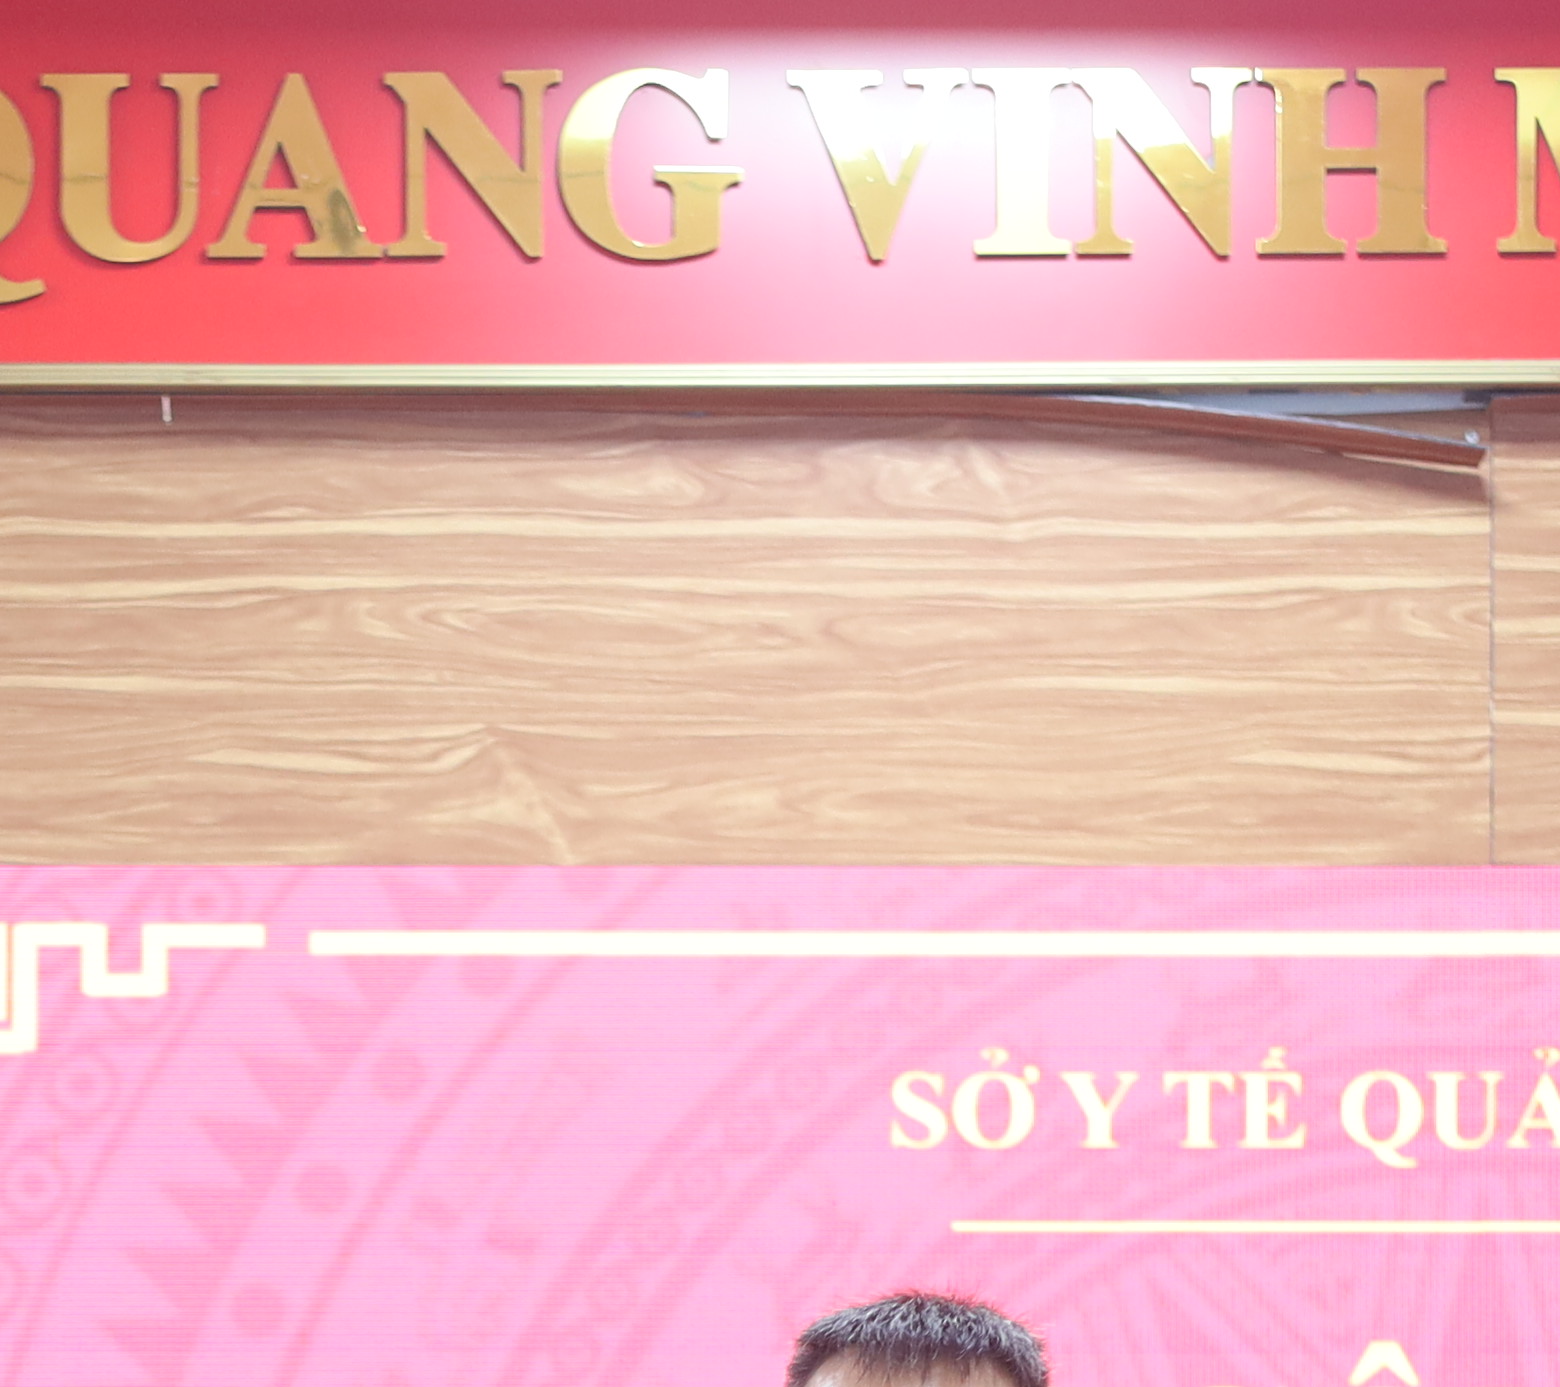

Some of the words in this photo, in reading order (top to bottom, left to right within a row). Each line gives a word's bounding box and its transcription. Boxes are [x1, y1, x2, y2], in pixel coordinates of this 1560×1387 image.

[786, 67, 1447, 262] VINH
[889, 1046, 1041, 1150] SỞ
[1059, 1070, 1140, 1149] Y
[1162, 1046, 1307, 1149] TẾ
